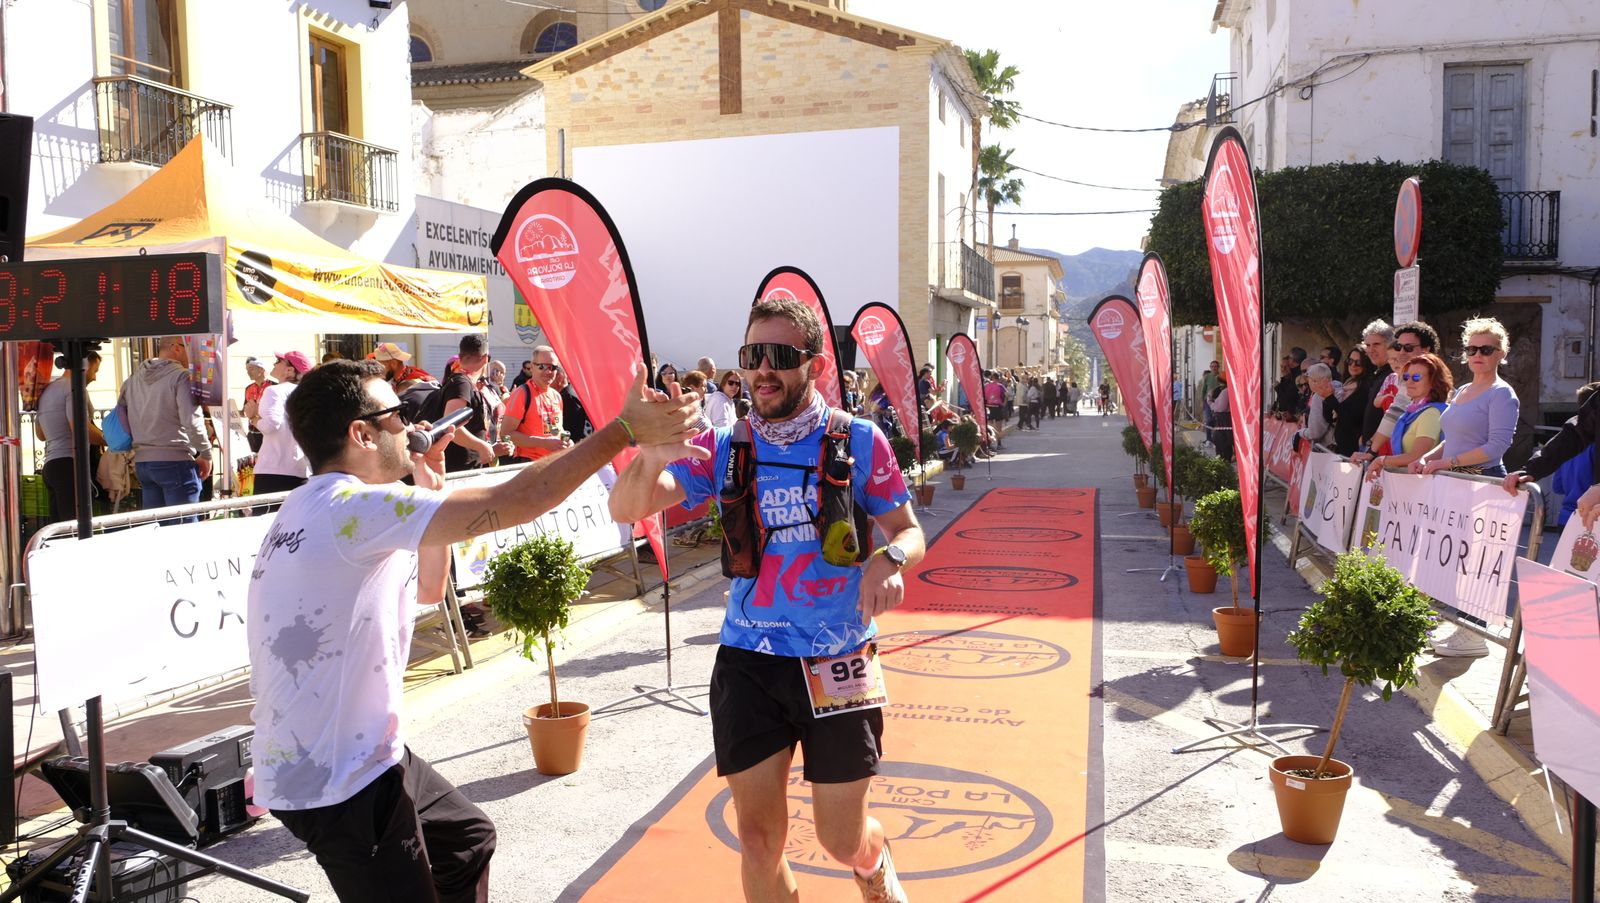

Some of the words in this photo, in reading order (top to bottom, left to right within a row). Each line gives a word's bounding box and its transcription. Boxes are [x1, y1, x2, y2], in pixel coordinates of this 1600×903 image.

[425, 221, 492, 249] EXCELENTÍSI
[760, 484, 818, 508] ADRA
[493, 502, 614, 550] CANTORI
[1490, 520, 1508, 541] DE
[1380, 520, 1504, 587] CANTORIA
[830, 657, 867, 683] 92
[882, 711, 1025, 727] Ayuntamie
[889, 702, 969, 714] Canto
[978, 708, 1011, 716] de
[964, 790, 1011, 804] LA
